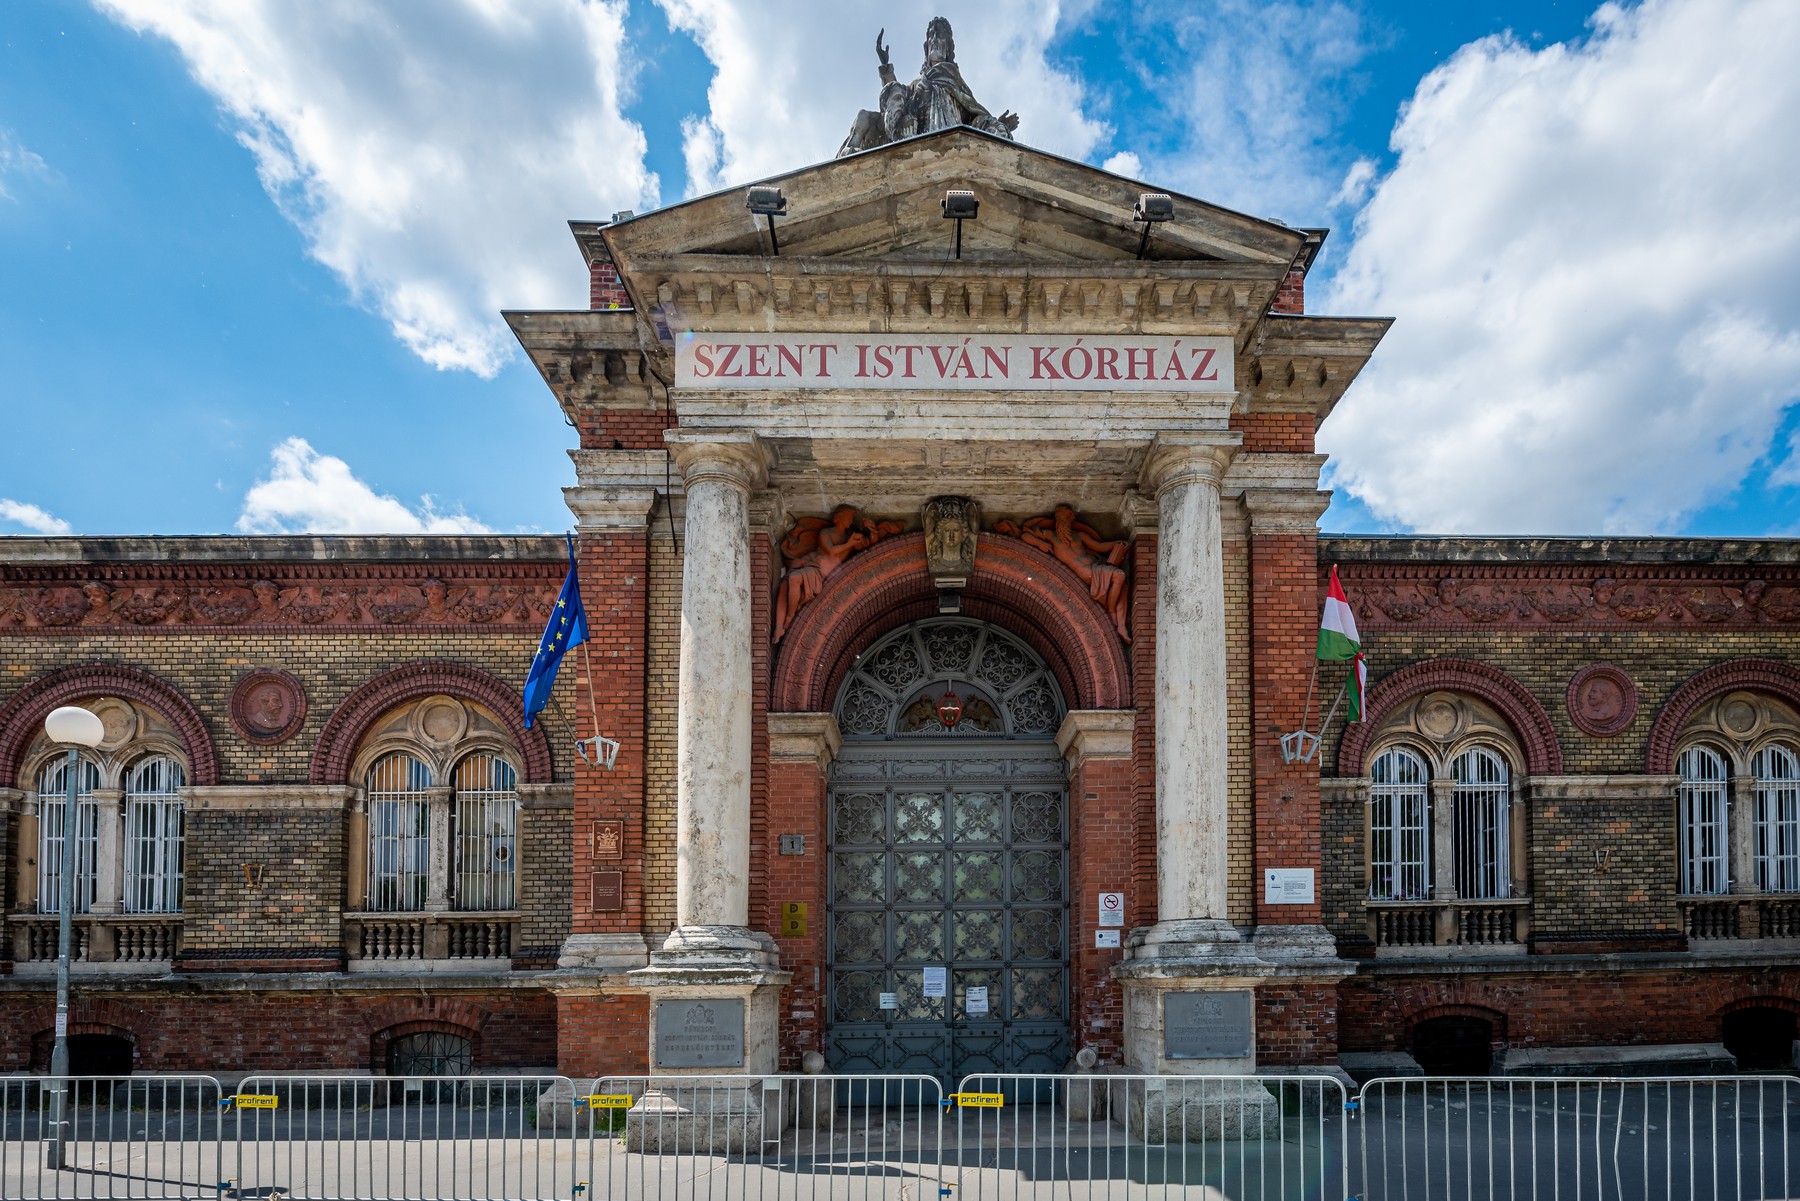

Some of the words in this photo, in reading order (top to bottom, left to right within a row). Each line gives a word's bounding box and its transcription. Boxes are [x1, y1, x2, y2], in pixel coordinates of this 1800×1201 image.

[693, 345, 838, 378] SZENT
[853, 338, 1011, 379] ISTVÁN
[1028, 338, 1218, 381] KÓRHÁZ
[790, 840, 795, 849] 1
[238, 1097, 273, 1105] profirent
[592, 1097, 627, 1105] profirent
[961, 1095, 999, 1103] profirent
